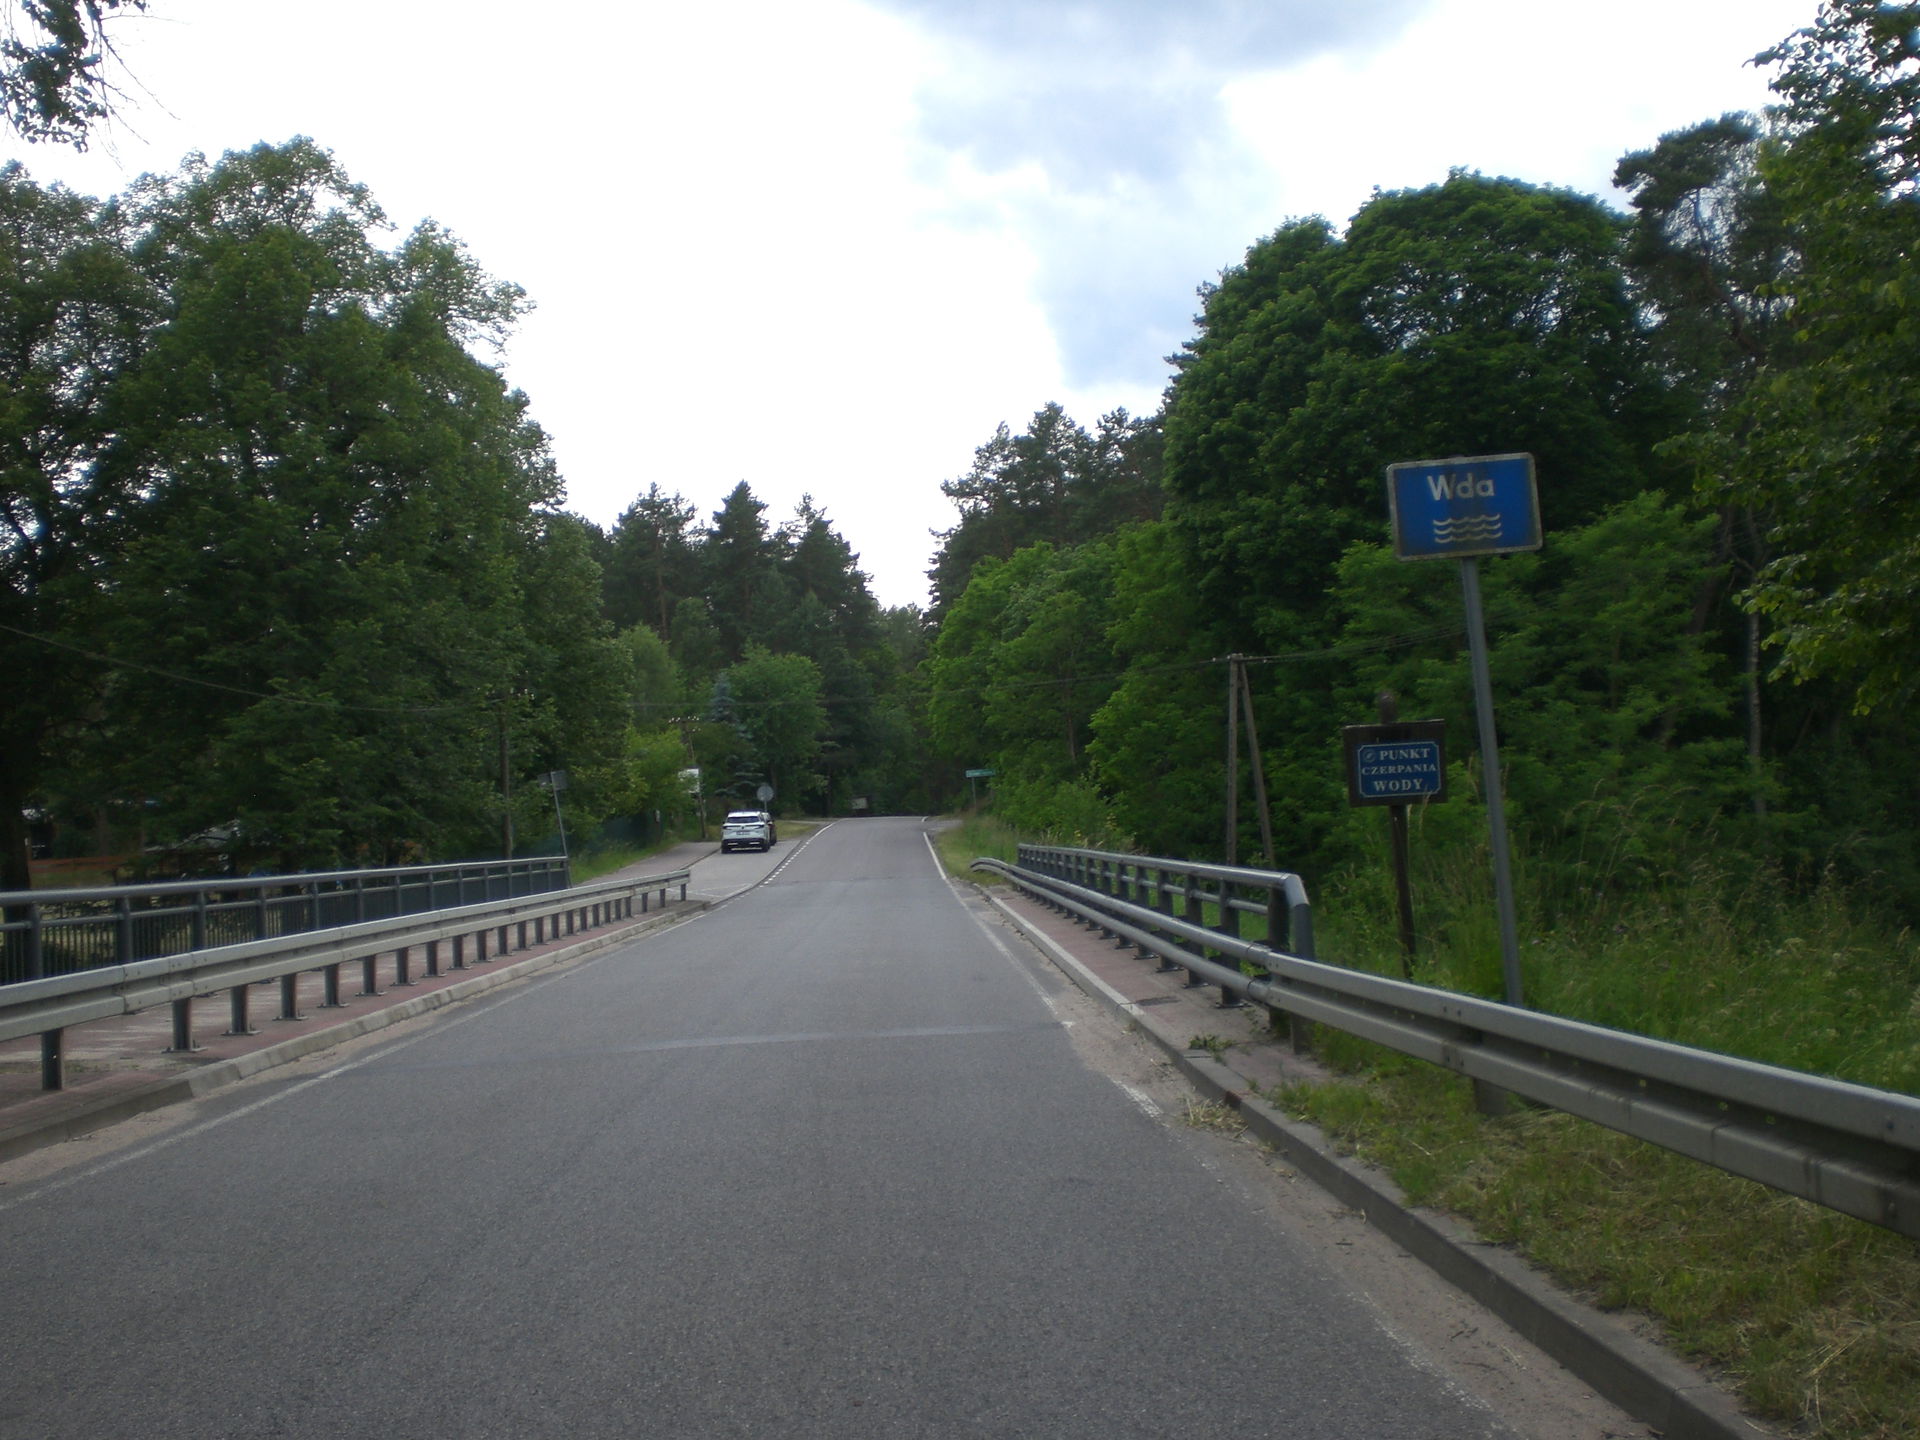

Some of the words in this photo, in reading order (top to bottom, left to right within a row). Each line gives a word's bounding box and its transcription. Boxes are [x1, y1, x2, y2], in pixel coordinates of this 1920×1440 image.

[1427, 473, 1494, 500] Wda
[1380, 748, 1431, 760] PUNKT
[1361, 763, 1437, 775] CZERPANIA
[1373, 778, 1424, 792] WODY
